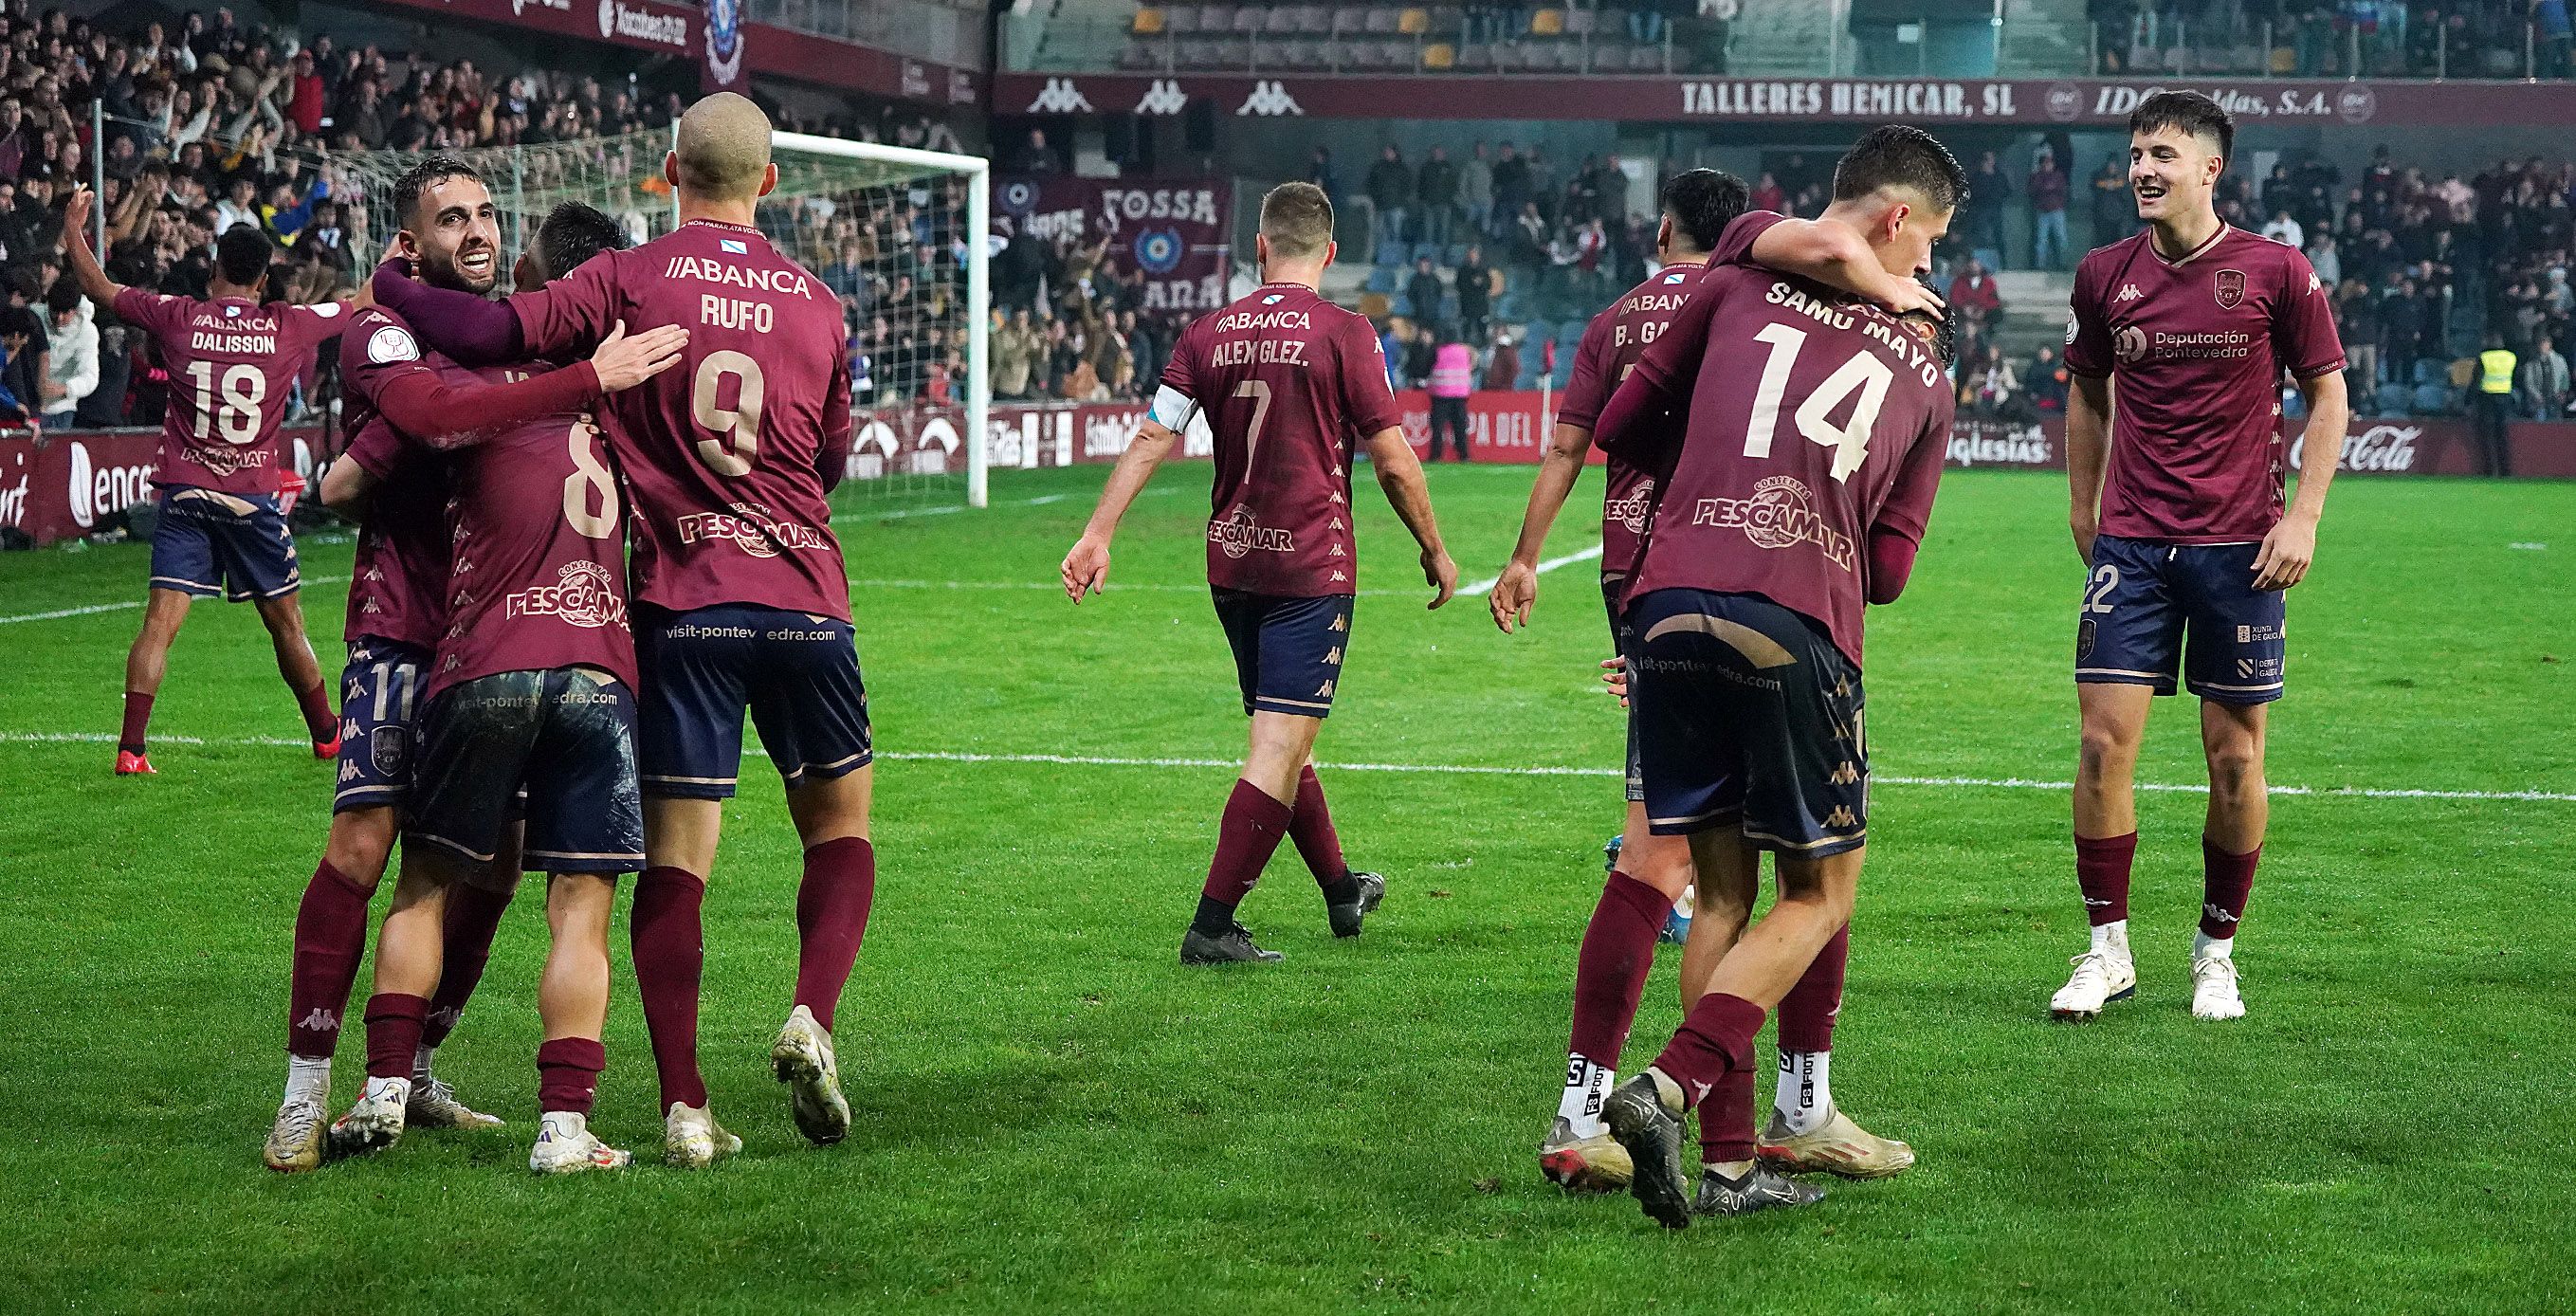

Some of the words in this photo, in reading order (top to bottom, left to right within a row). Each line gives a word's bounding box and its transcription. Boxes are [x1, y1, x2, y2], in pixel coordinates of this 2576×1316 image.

[1681, 82, 1822, 115] TALLERES
[1831, 82, 1974, 118] HEMICAR,
[1982, 83, 2017, 116] SL
[2212, 89, 2270, 118] ldas,
[2275, 89, 2331, 116] S.A.
[700, 294, 774, 333] RUFO
[192, 332, 276, 354] DALISSON
[1212, 340, 1259, 368] ALEX
[1259, 339, 1310, 368] GLEZ.
[1615, 324, 1634, 348] B.
[1765, 282, 1854, 330] SAMU
[1862, 321, 1939, 389] MAYO
[2154, 329, 2250, 347] Deputación
[2154, 345, 2249, 359] Pontevedra
[186, 360, 266, 444] 18
[693, 350, 764, 476] 9
[1743, 322, 1895, 486] 14
[1233, 379, 1272, 485] 7
[563, 420, 618, 539] 8
[1753, 475, 1813, 501] CONSERVAS
[557, 559, 612, 583] CONSERVAS
[2080, 564, 2120, 613] 22
[370, 663, 417, 722] 11
